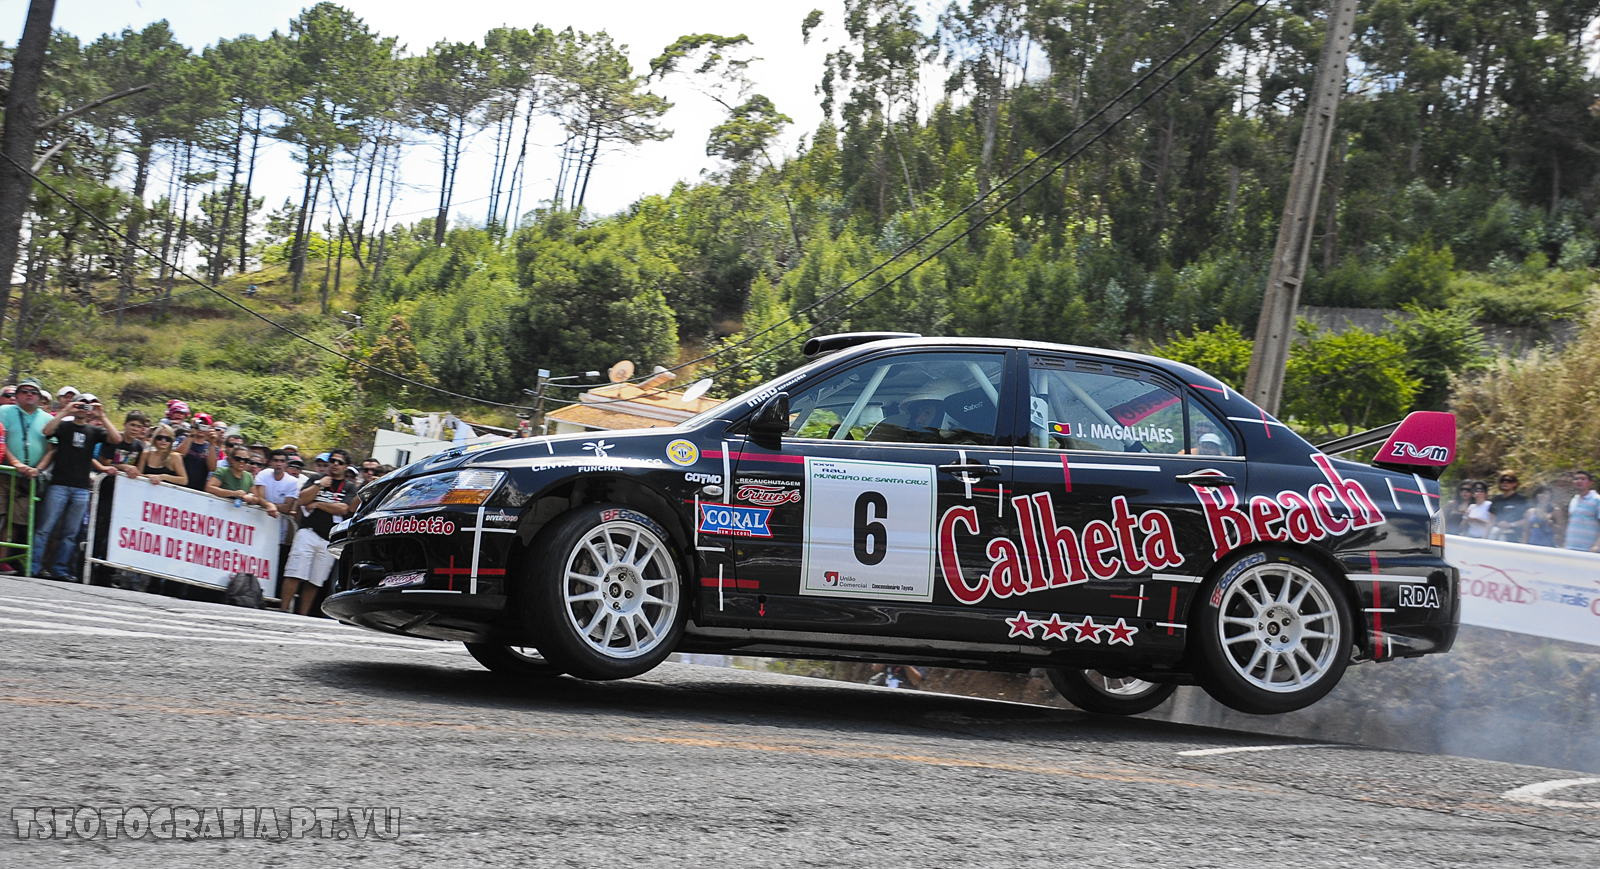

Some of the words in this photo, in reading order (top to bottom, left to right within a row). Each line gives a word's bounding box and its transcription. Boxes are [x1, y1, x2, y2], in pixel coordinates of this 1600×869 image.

[1076, 423, 1086, 438] J.
[1091, 424, 1174, 443] MAGALHÃES
[578, 464, 624, 473] FUNCHAL
[739, 477, 801, 486] RECAUCHUTAGEM
[141, 501, 225, 539] EMERGENCY
[227, 521, 256, 546] EXIT
[375, 516, 455, 536] Moldebetão
[706, 510, 765, 529] CORAL
[854, 491, 888, 566] 6
[938, 492, 1184, 604] Calheta
[1189, 452, 1387, 563] Beach
[118, 527, 162, 556] SAÍDA
[165, 537, 183, 560] DE
[185, 542, 271, 580] EMERGÊNCIA
[839, 581, 868, 589] Comercial
[1399, 585, 1440, 609] RDA
